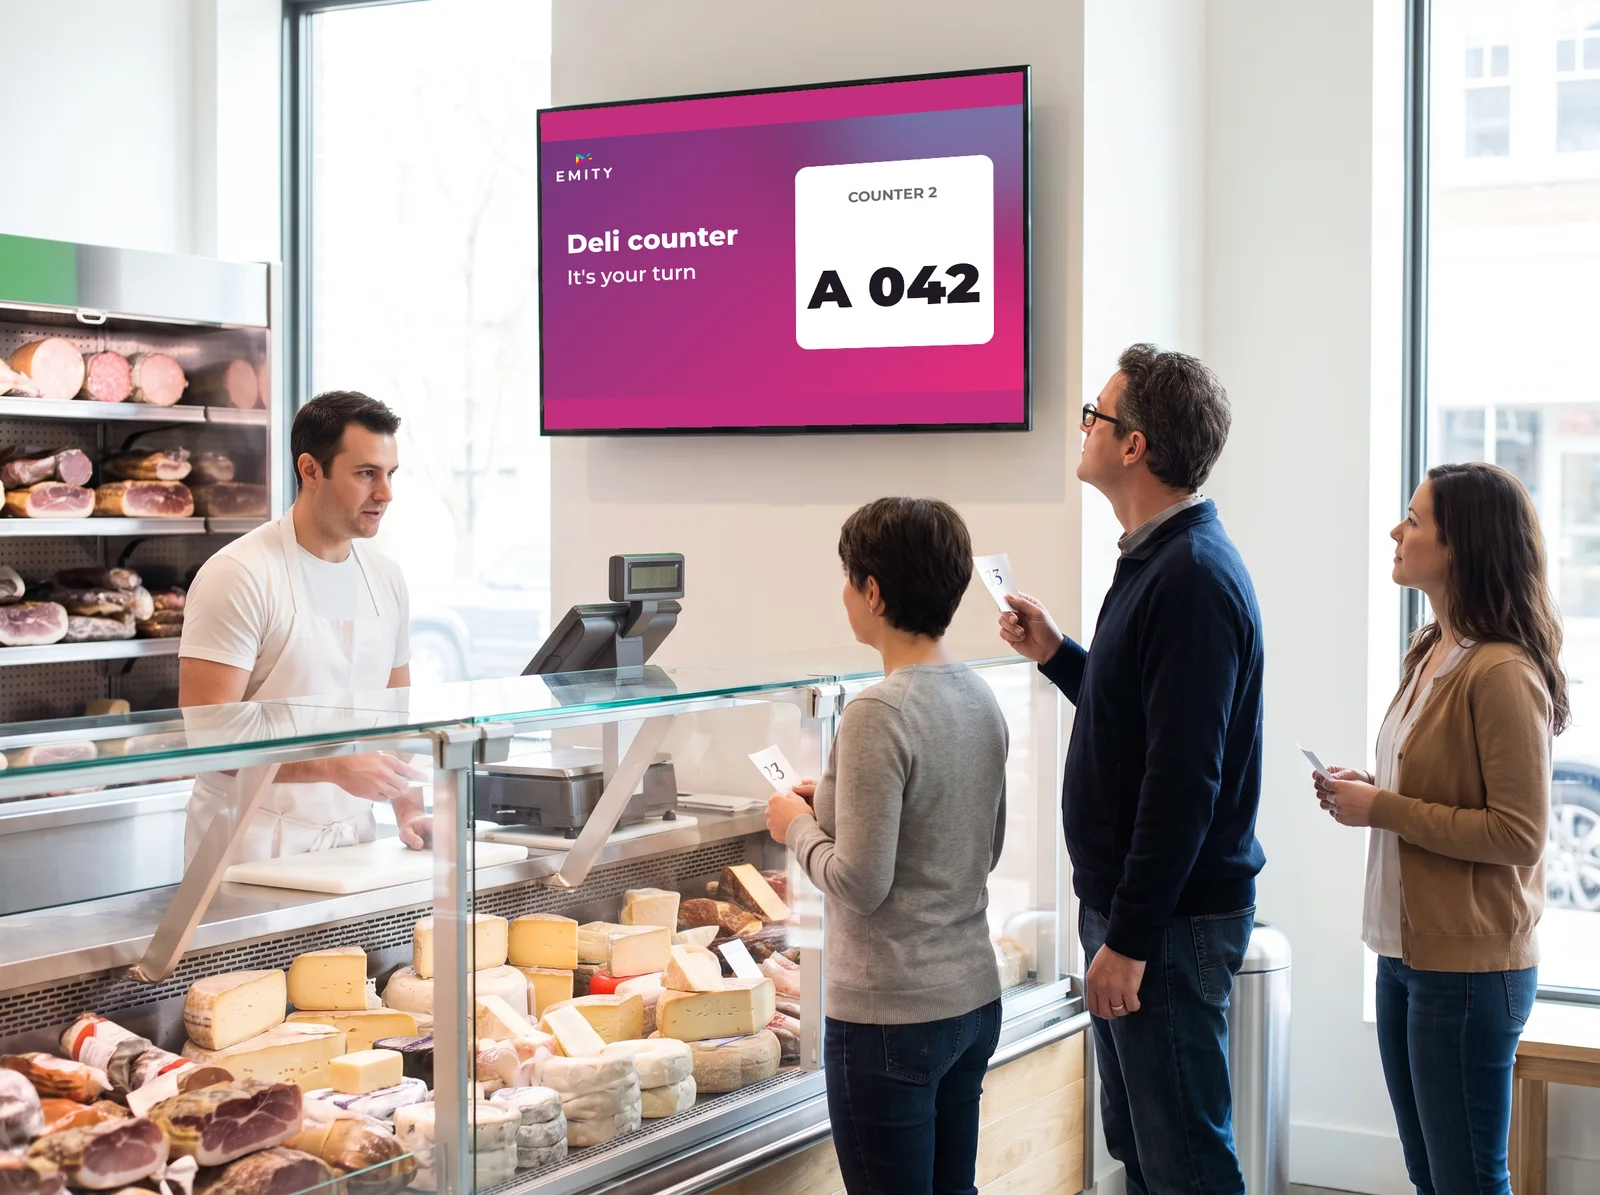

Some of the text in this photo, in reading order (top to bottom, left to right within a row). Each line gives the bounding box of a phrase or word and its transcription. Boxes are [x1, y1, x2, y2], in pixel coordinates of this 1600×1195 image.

[556, 167, 613, 182] EMITY
[848, 187, 938, 203] COUNTER 2
[568, 227, 739, 254] Deli counter
[568, 266, 696, 288] It's your turn
[807, 263, 980, 309] A 042
